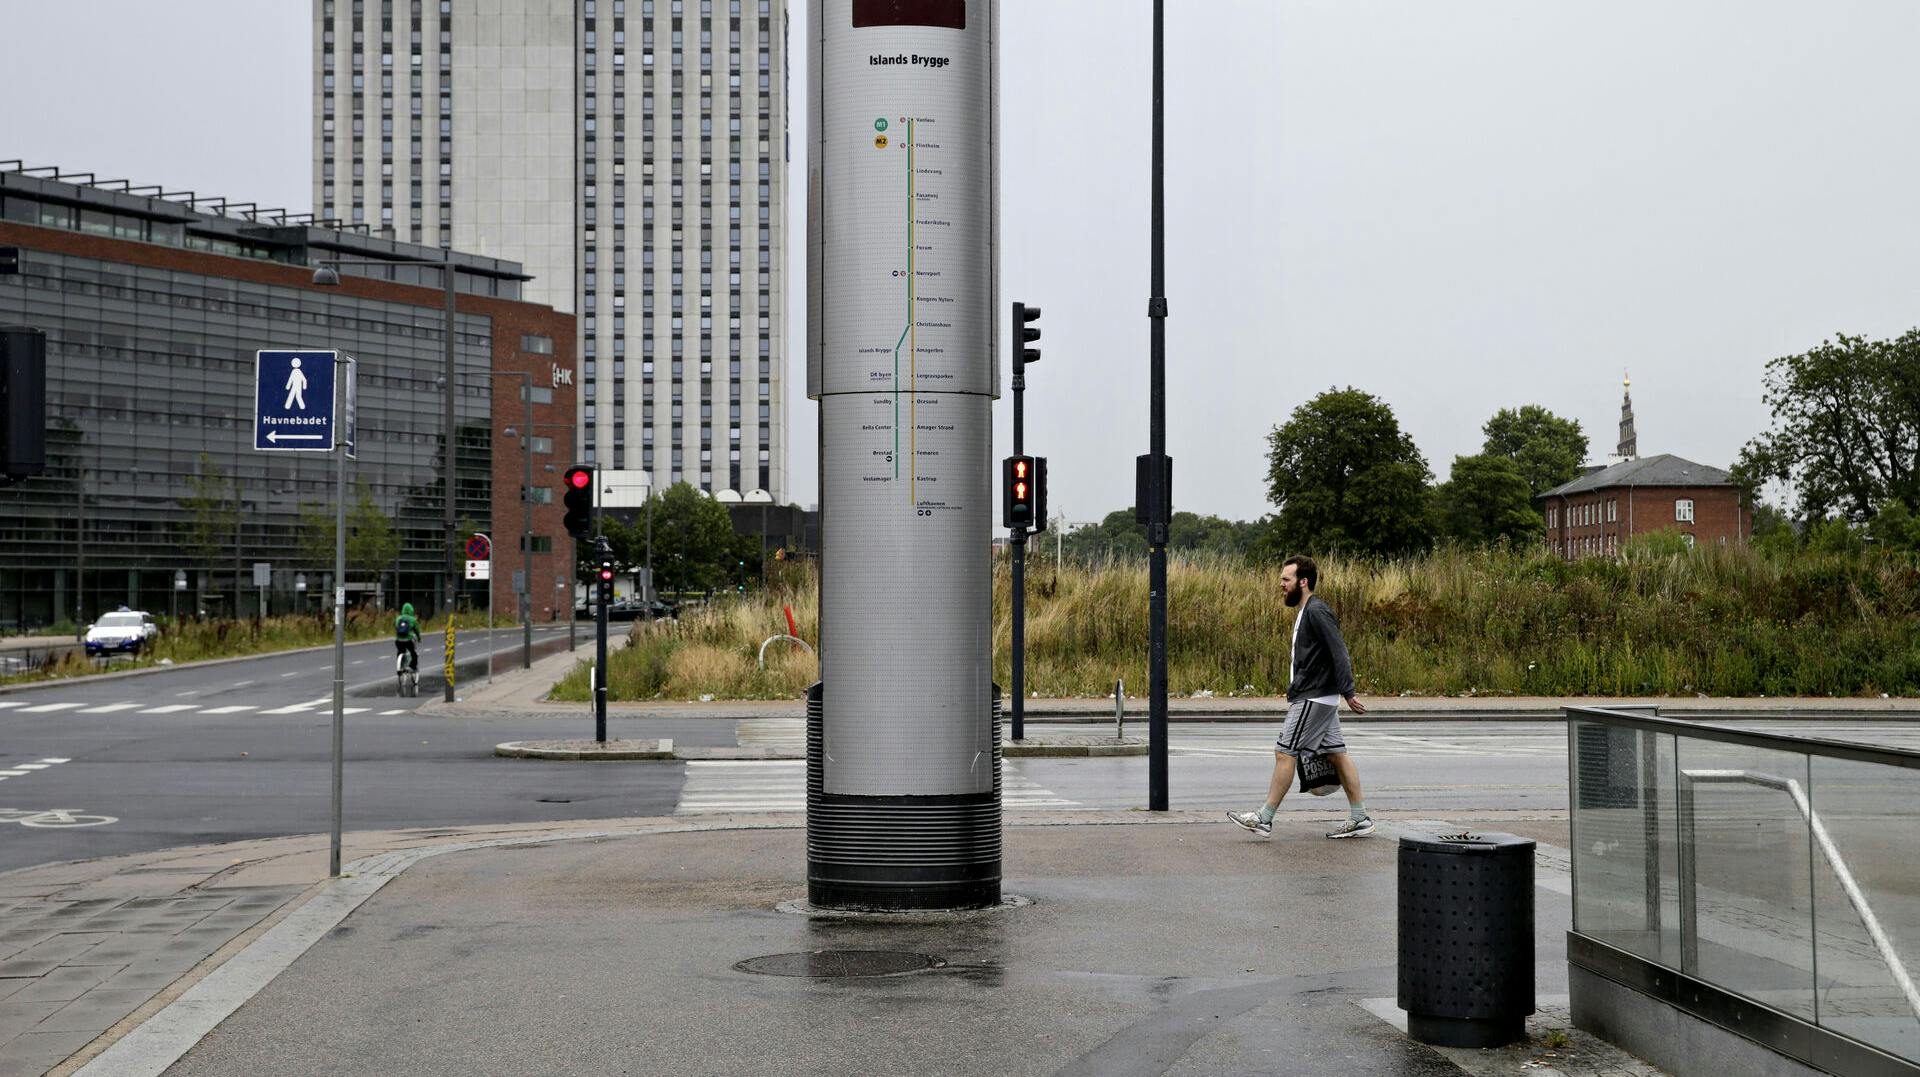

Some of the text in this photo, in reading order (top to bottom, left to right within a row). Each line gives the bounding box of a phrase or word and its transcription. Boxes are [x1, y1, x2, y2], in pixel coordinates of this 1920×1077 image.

[870, 54, 950, 68] Islands Brygge
[556, 367, 573, 385] HK
[263, 415, 328, 425] Havnebadet
